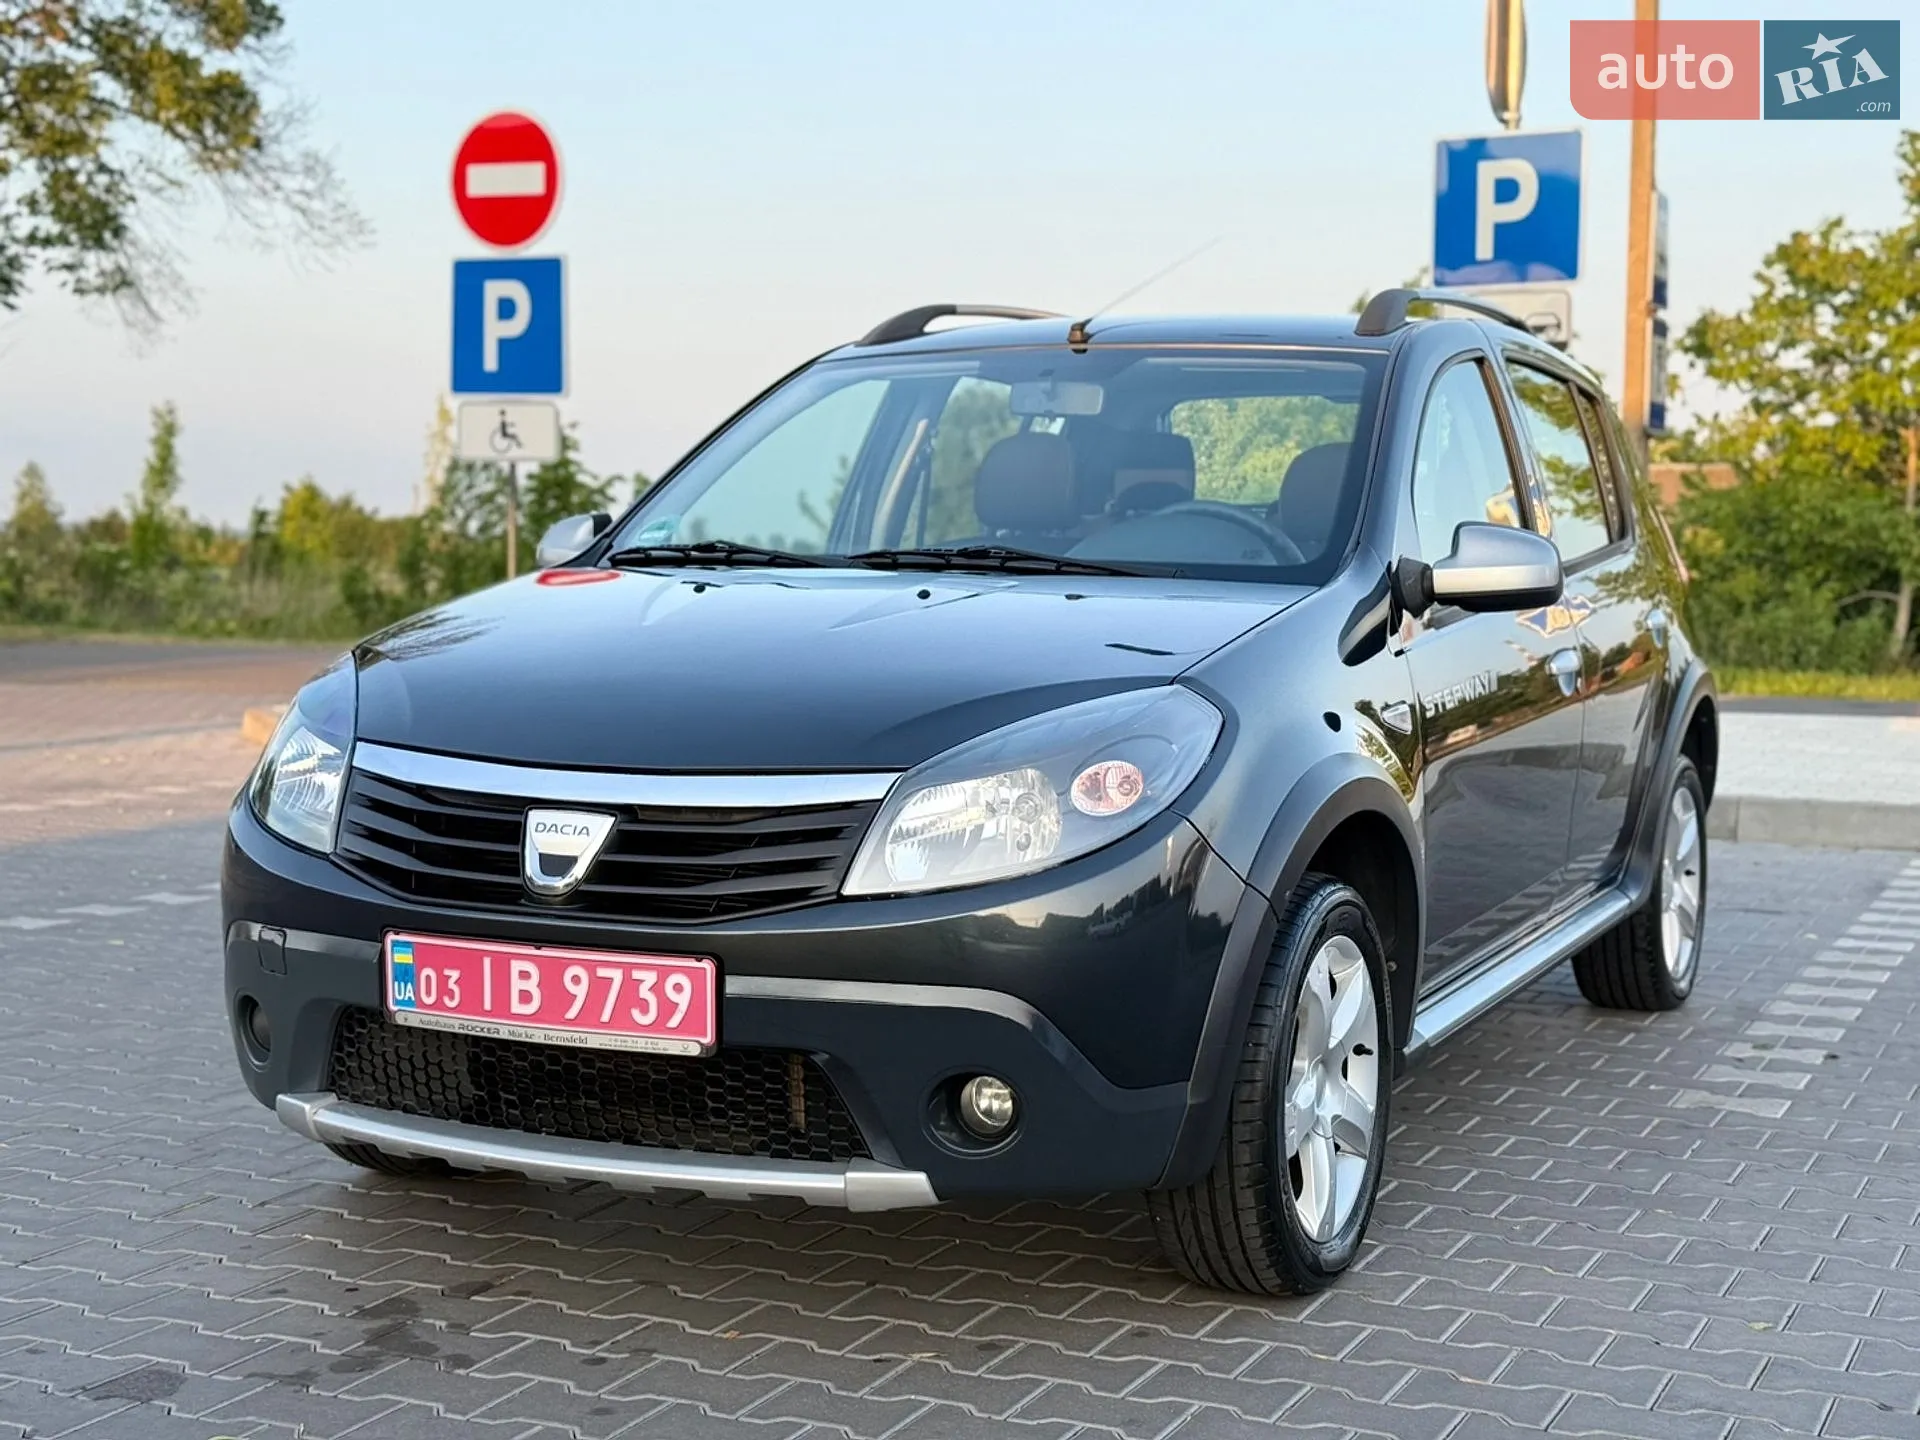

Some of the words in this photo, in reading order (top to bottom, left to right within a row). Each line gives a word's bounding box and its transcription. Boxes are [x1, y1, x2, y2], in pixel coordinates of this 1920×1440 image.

[1475, 158, 1539, 262] P
[483, 278, 532, 373] P
[1424, 669, 1492, 719] STEPWAY
[534, 822, 590, 837] DACIA
[394, 981, 415, 1001] UA
[419, 967, 462, 1009] 03
[562, 965, 692, 1029] 9739
[543, 1033, 588, 1045] Bernsfeld
